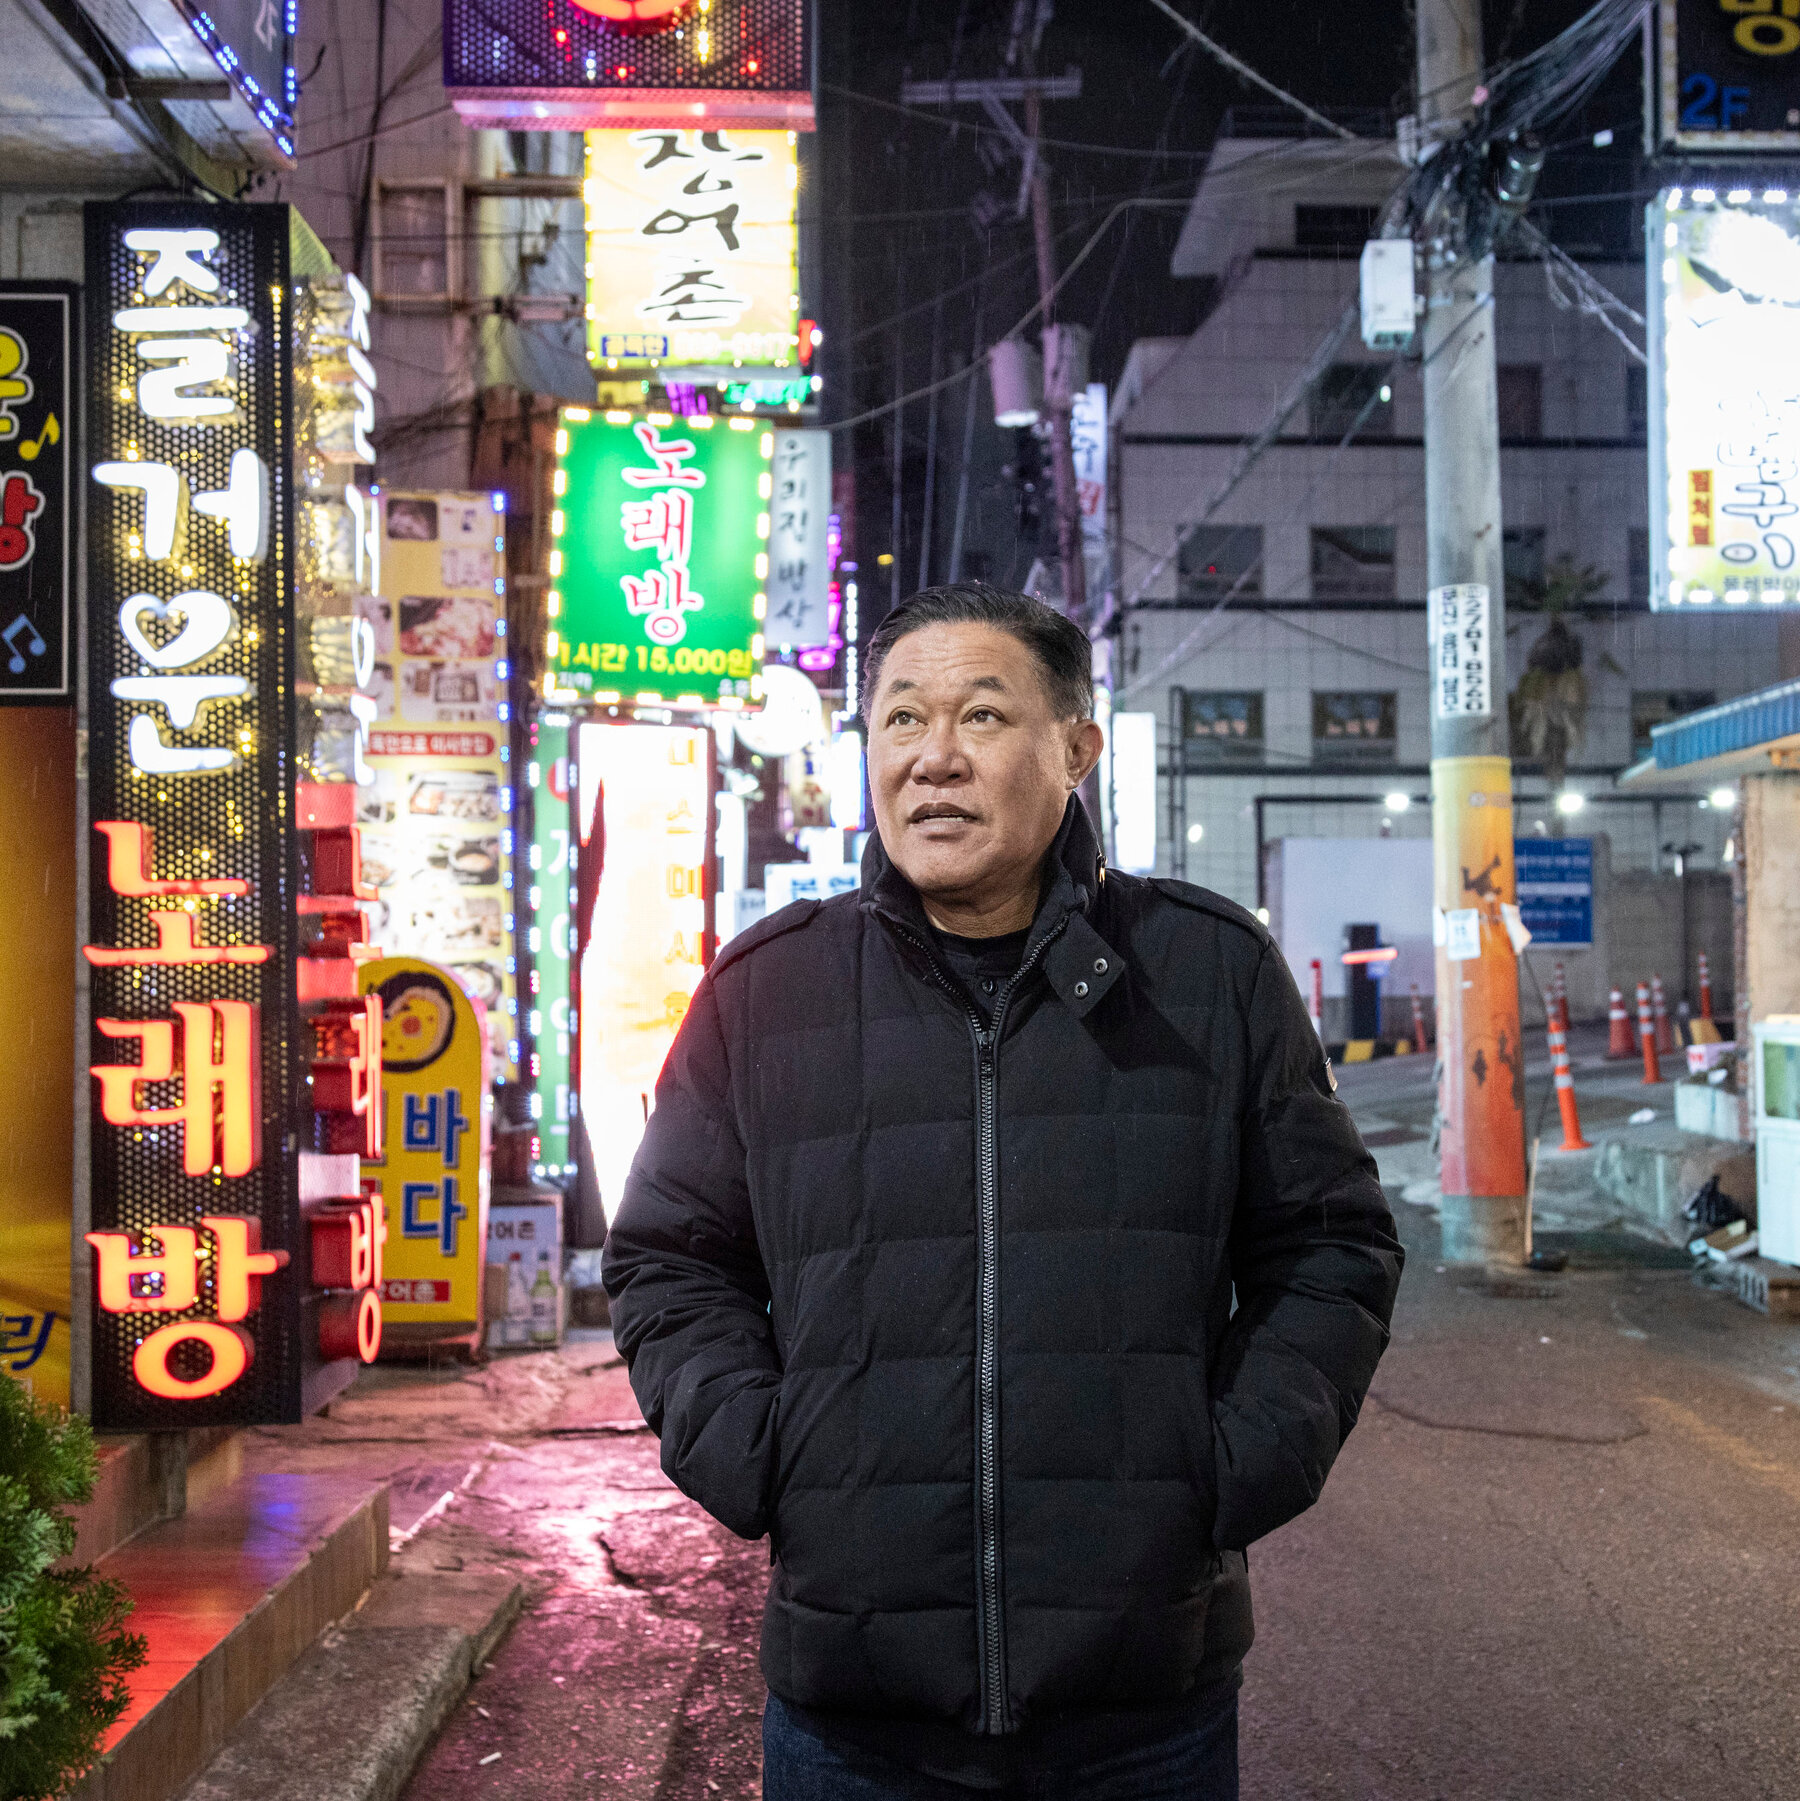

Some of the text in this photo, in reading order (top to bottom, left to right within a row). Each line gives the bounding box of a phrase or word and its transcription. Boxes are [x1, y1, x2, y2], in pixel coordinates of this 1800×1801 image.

[1681, 73, 1749, 131] 2F
[620, 421, 707, 645] 노래방
[559, 642, 752, 677] 1시간 15,000원
[83, 228, 287, 1399] 즐거운 노래방
[404, 1090, 468, 1256] 바다
[487, 1220, 536, 1240] 어촌
